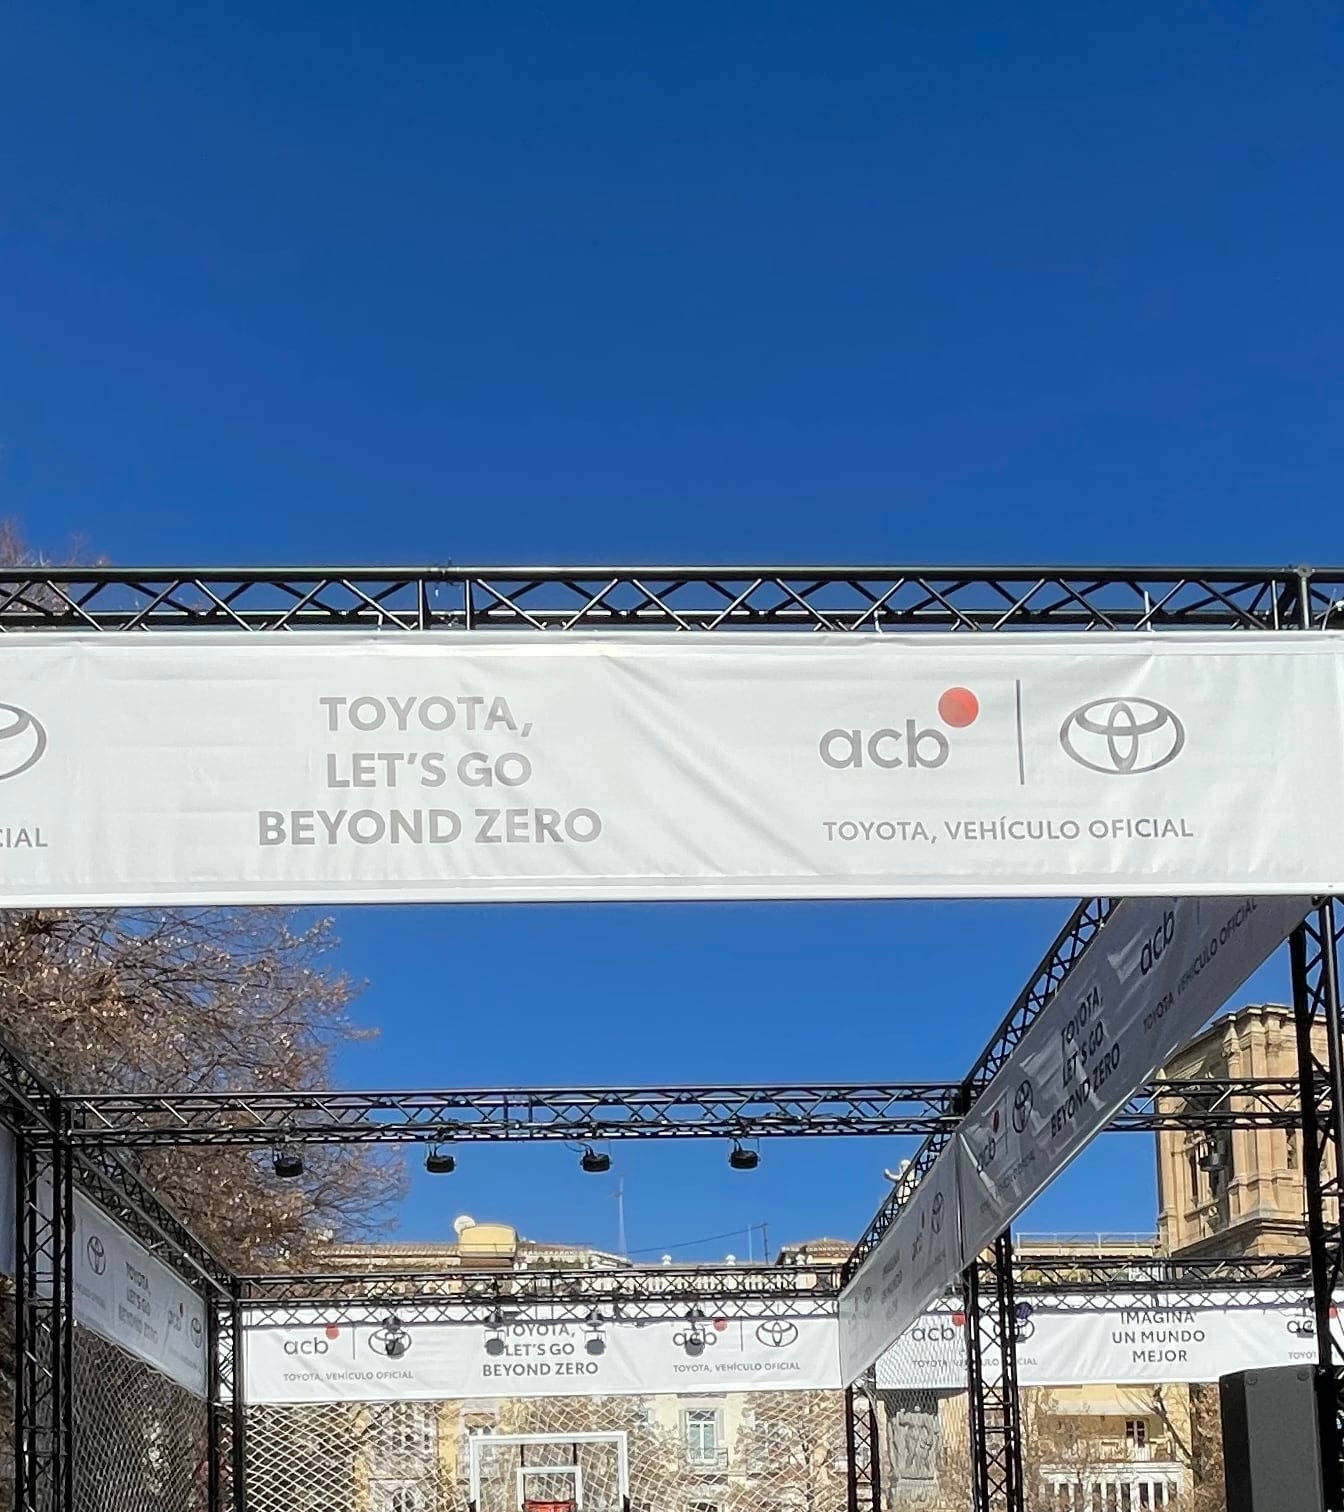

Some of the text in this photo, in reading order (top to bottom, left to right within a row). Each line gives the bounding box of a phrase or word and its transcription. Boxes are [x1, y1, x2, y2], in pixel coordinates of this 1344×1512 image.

[319, 695, 535, 738] TOYOTA,
[819, 719, 950, 769] acb
[326, 751, 532, 790] LET'S GO
[258, 806, 602, 848] BEYOND ZERO
[823, 816, 1195, 844] TOYOTA, VEHÍCULO OFICIAL
[1140, 910, 1175, 976] acb
[1061, 985, 1104, 1054] TOYOTA,
[1089, 1021, 1104, 1057] GO
[1050, 1042, 1121, 1138] BEYOND ZERO
[1120, 1311, 1195, 1324] IMAGINA
[912, 1324, 955, 1342] acb
[1287, 1320, 1315, 1334] ac
[1111, 1329, 1205, 1344] UN MUNDO
[284, 1337, 329, 1355] acb
[505, 1343, 575, 1356] LET'S GO
[1132, 1349, 1188, 1363] MEJOR
[376, 1370, 414, 1380] OFICIAL
[483, 1362, 599, 1376] BEYOND ZERO
[764, 1361, 801, 1371] OFICIAL
